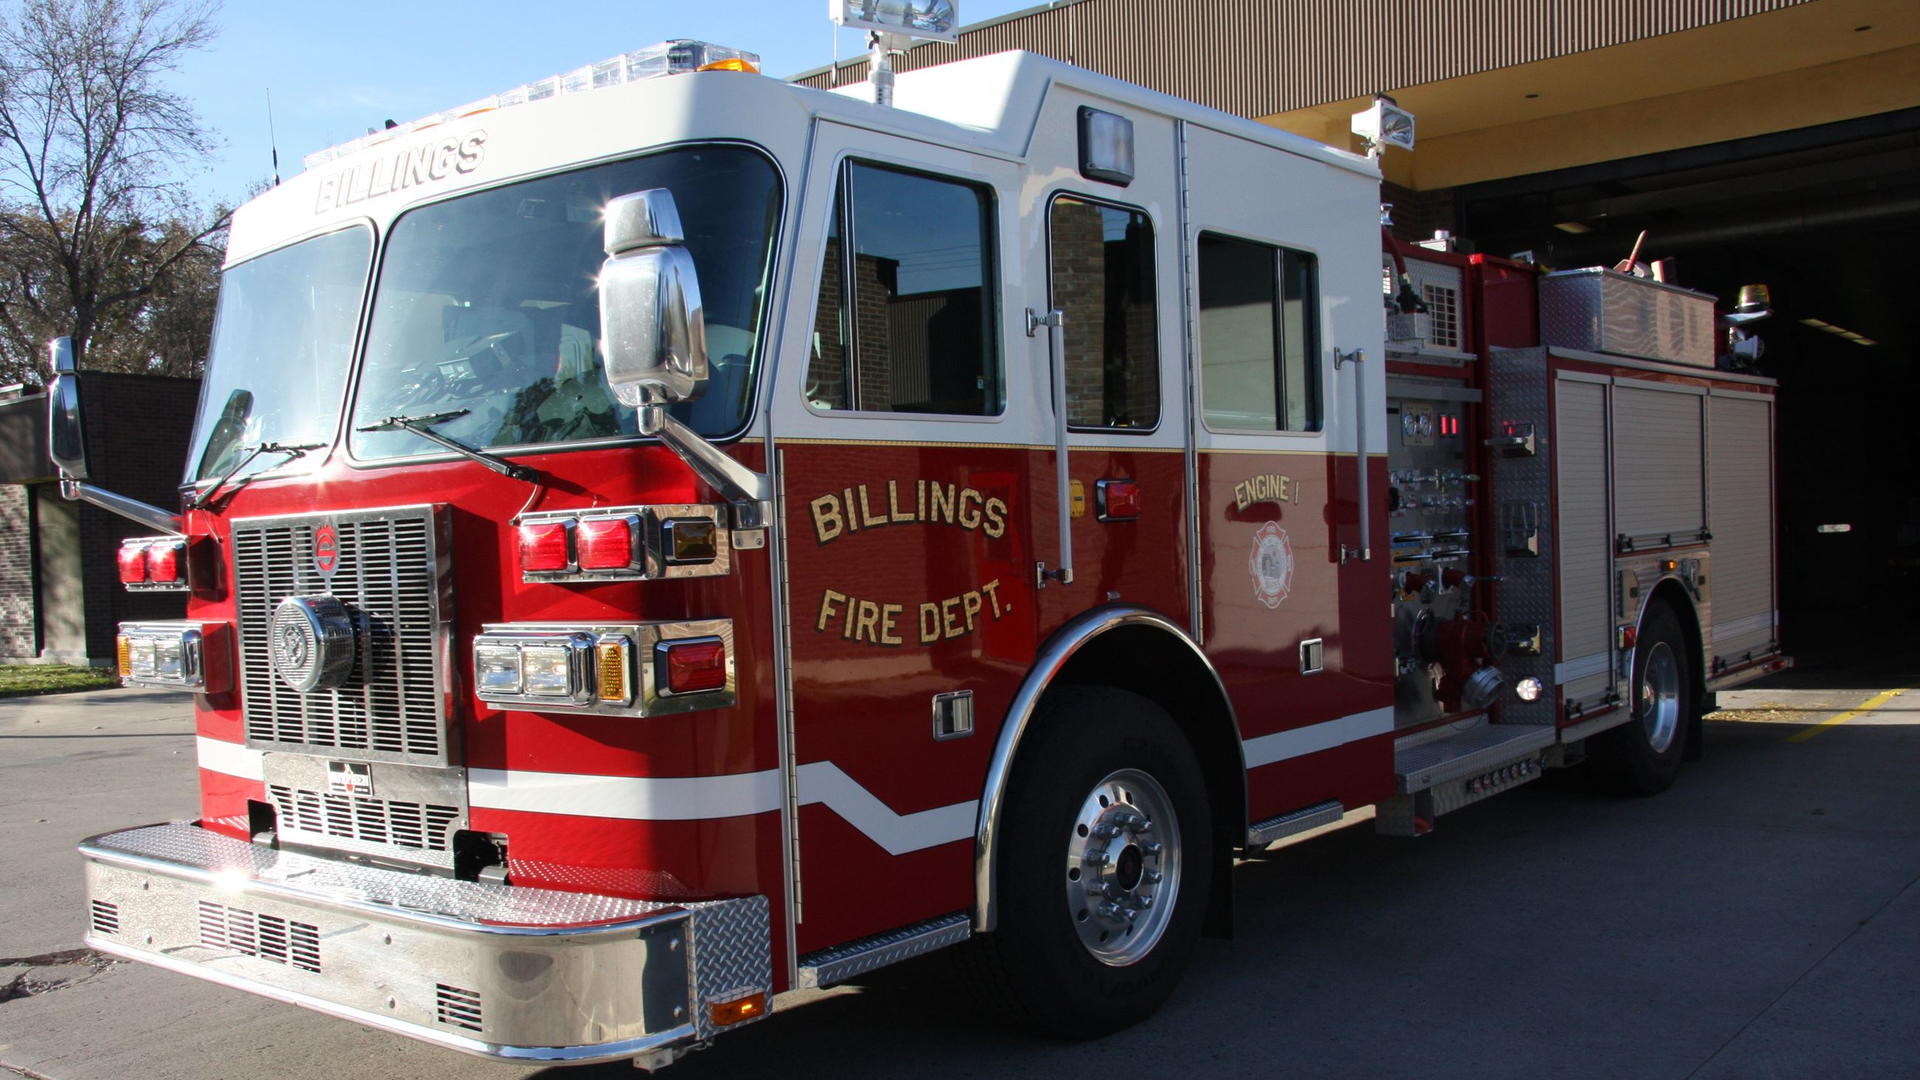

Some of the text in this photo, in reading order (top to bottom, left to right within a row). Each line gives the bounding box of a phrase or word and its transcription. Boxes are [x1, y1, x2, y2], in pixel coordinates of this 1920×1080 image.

[315, 129, 488, 215] BILLINGS
[809, 480, 1008, 547] BILLINGS
[1234, 474, 1290, 512] ENGINE
[816, 579, 1012, 646] FIRE DEPT.
